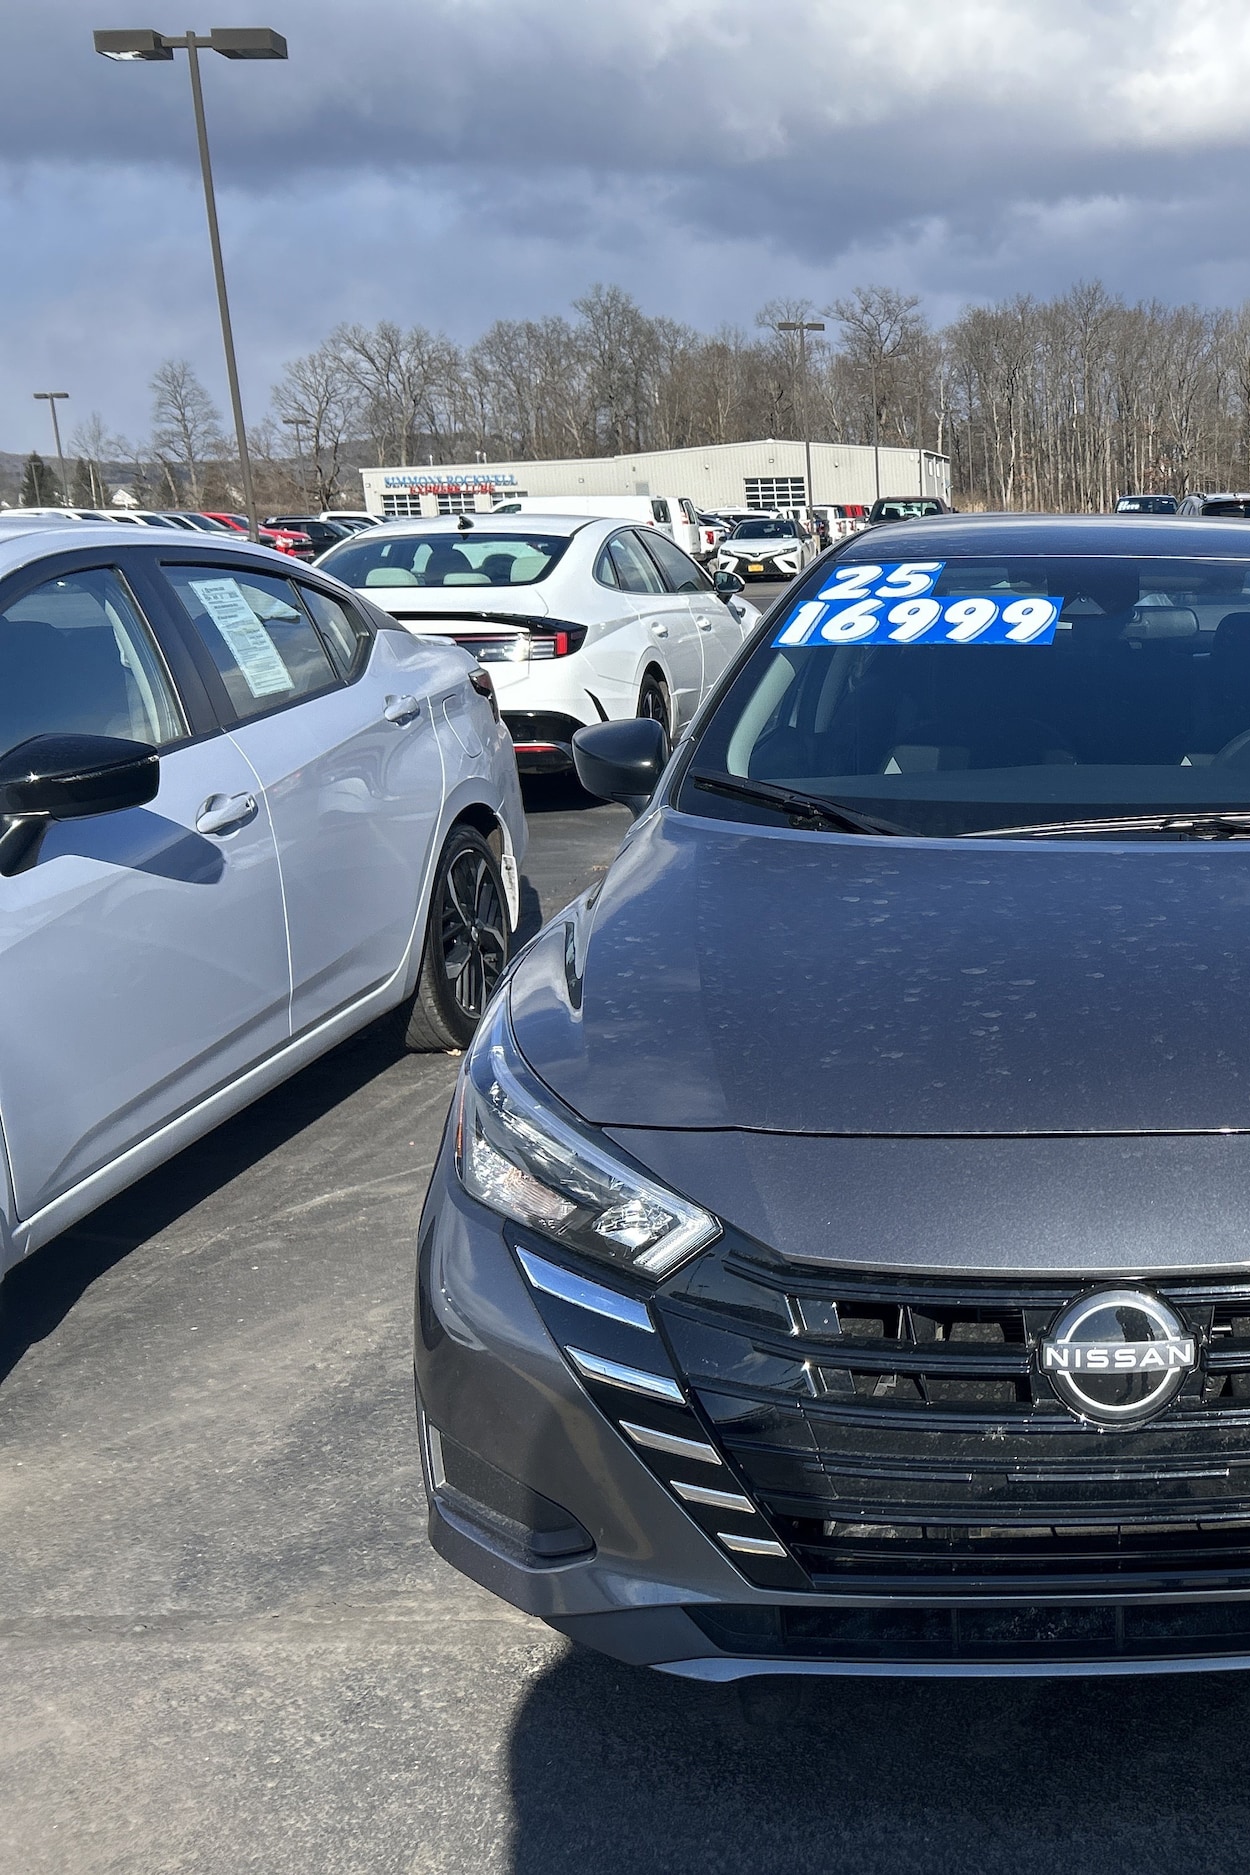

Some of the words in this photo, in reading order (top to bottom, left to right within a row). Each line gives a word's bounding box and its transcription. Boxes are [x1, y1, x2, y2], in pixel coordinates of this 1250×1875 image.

[817, 562, 942, 600] 25
[778, 597, 1058, 644] 16999
[1046, 1343, 1191, 1368] NISSAN
